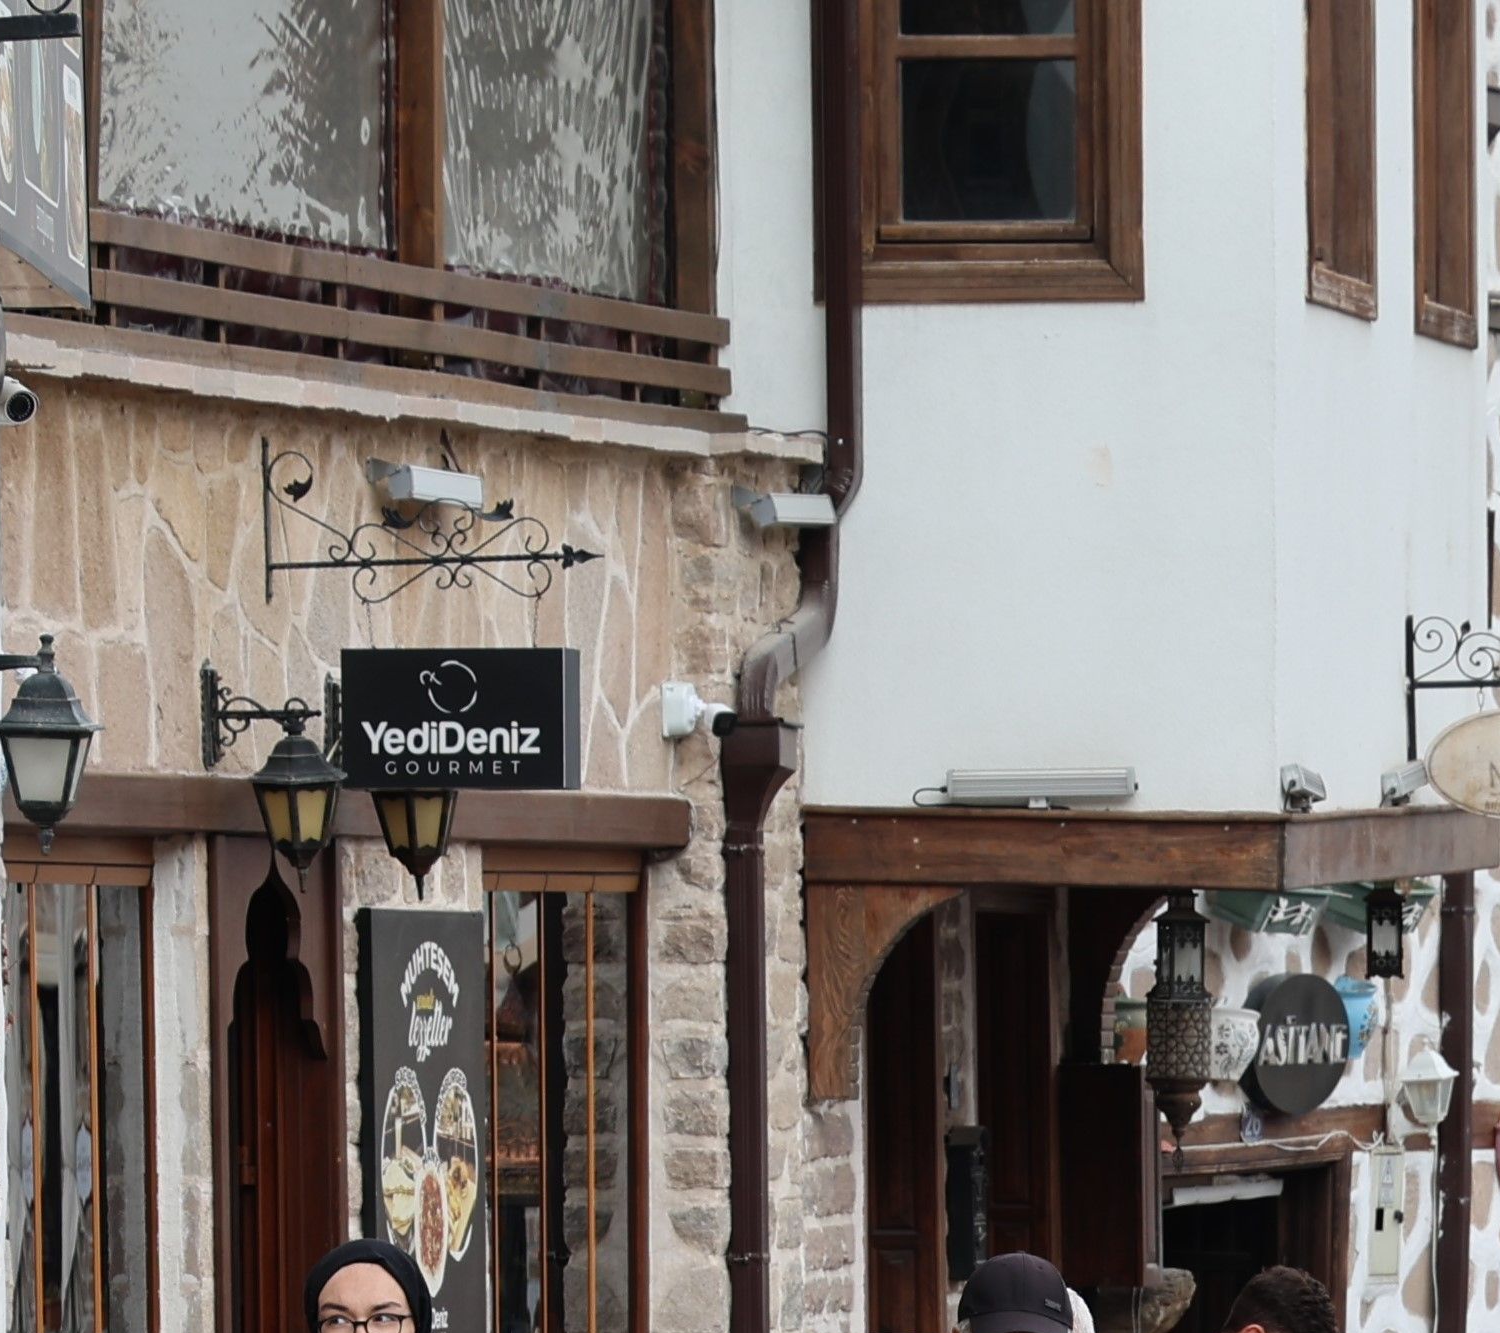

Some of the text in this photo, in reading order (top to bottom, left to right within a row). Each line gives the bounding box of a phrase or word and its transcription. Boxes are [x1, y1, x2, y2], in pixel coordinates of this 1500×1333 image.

[361, 720, 541, 755] YediDeniz
[384, 760, 521, 775] GOURMET
[401, 941, 459, 1008] MUHTEŞEM
